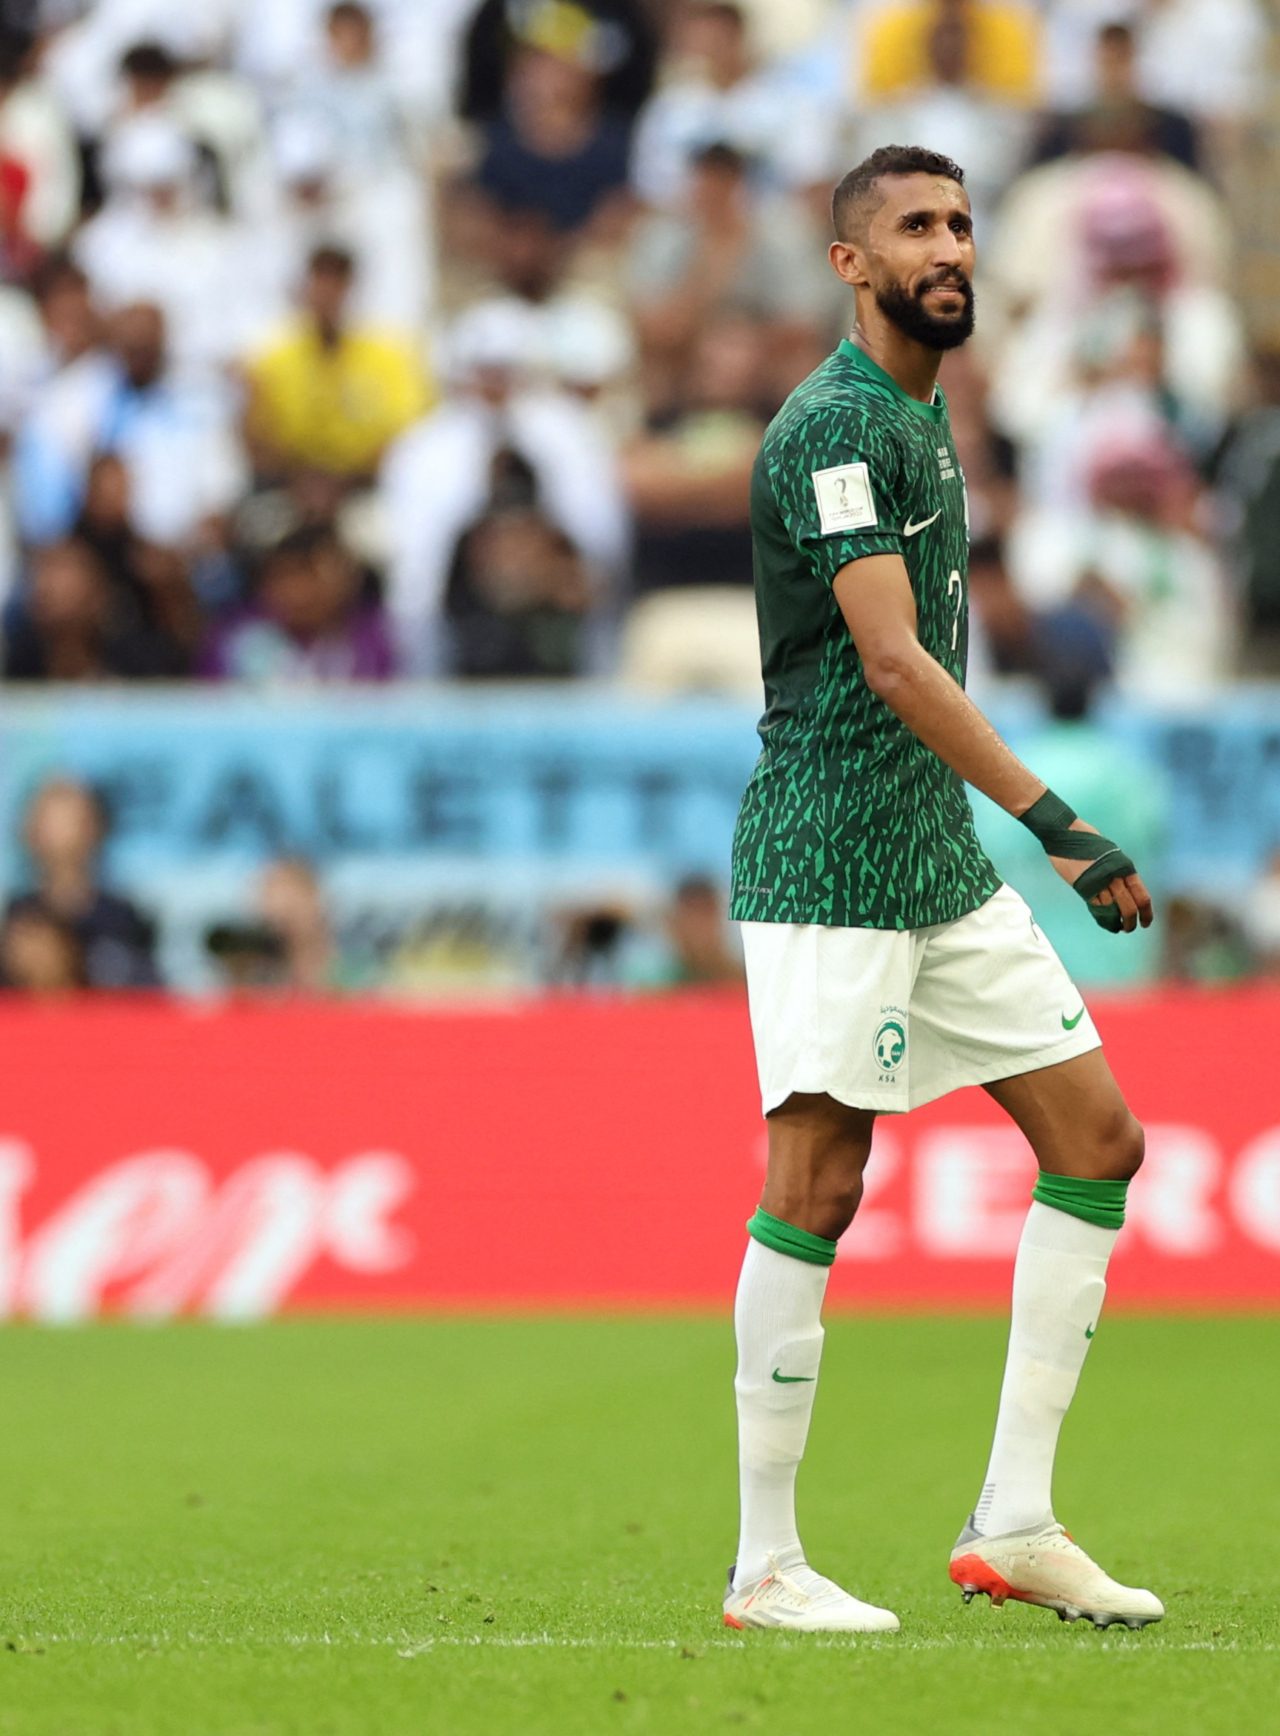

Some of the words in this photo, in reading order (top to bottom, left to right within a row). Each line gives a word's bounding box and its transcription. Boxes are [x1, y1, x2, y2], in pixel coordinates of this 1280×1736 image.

[947, 569, 963, 651] 7
[878, 1074, 896, 1083] KSA
[0, 1134, 417, 1328] er
